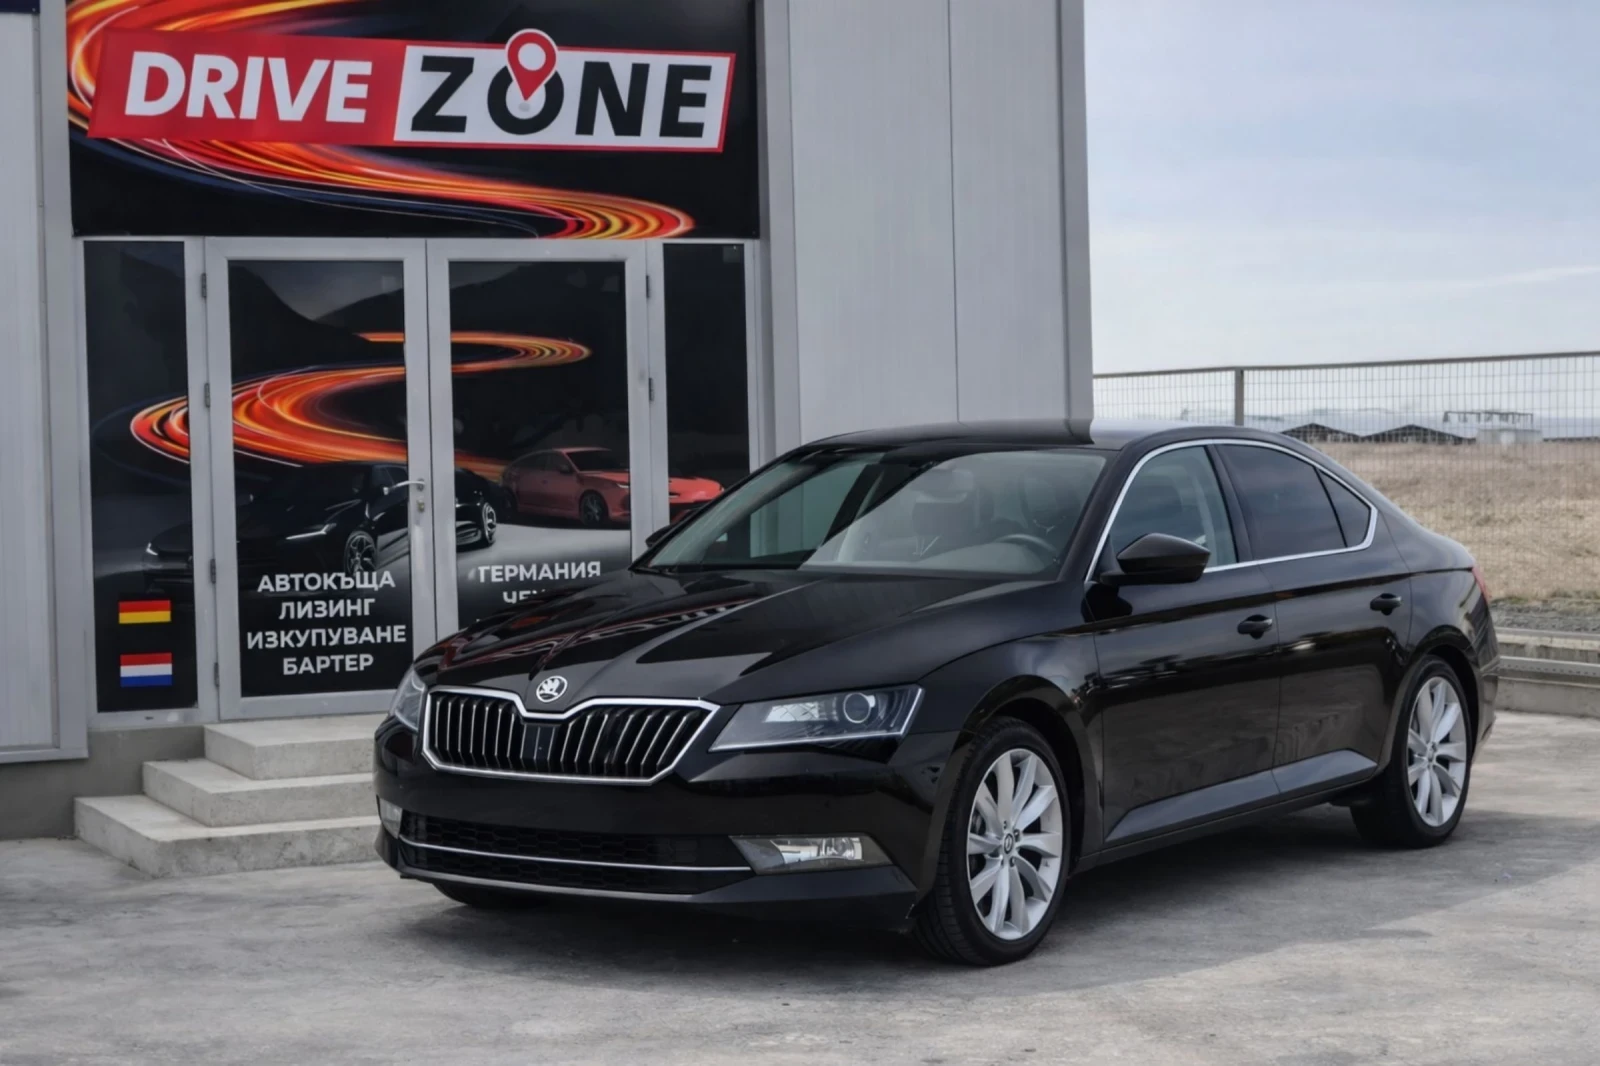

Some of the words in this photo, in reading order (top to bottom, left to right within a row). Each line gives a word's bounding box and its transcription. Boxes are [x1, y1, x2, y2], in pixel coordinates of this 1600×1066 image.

[124, 51, 373, 123] DRIVE
[410, 55, 713, 138] ZONE
[257, 570, 396, 593] АВТОКЪЩА
[278, 598, 376, 620] ЛИЗИНГ
[247, 625, 407, 650] ИЗКУПУВАНЕ
[283, 653, 374, 675] БАРТЕР
